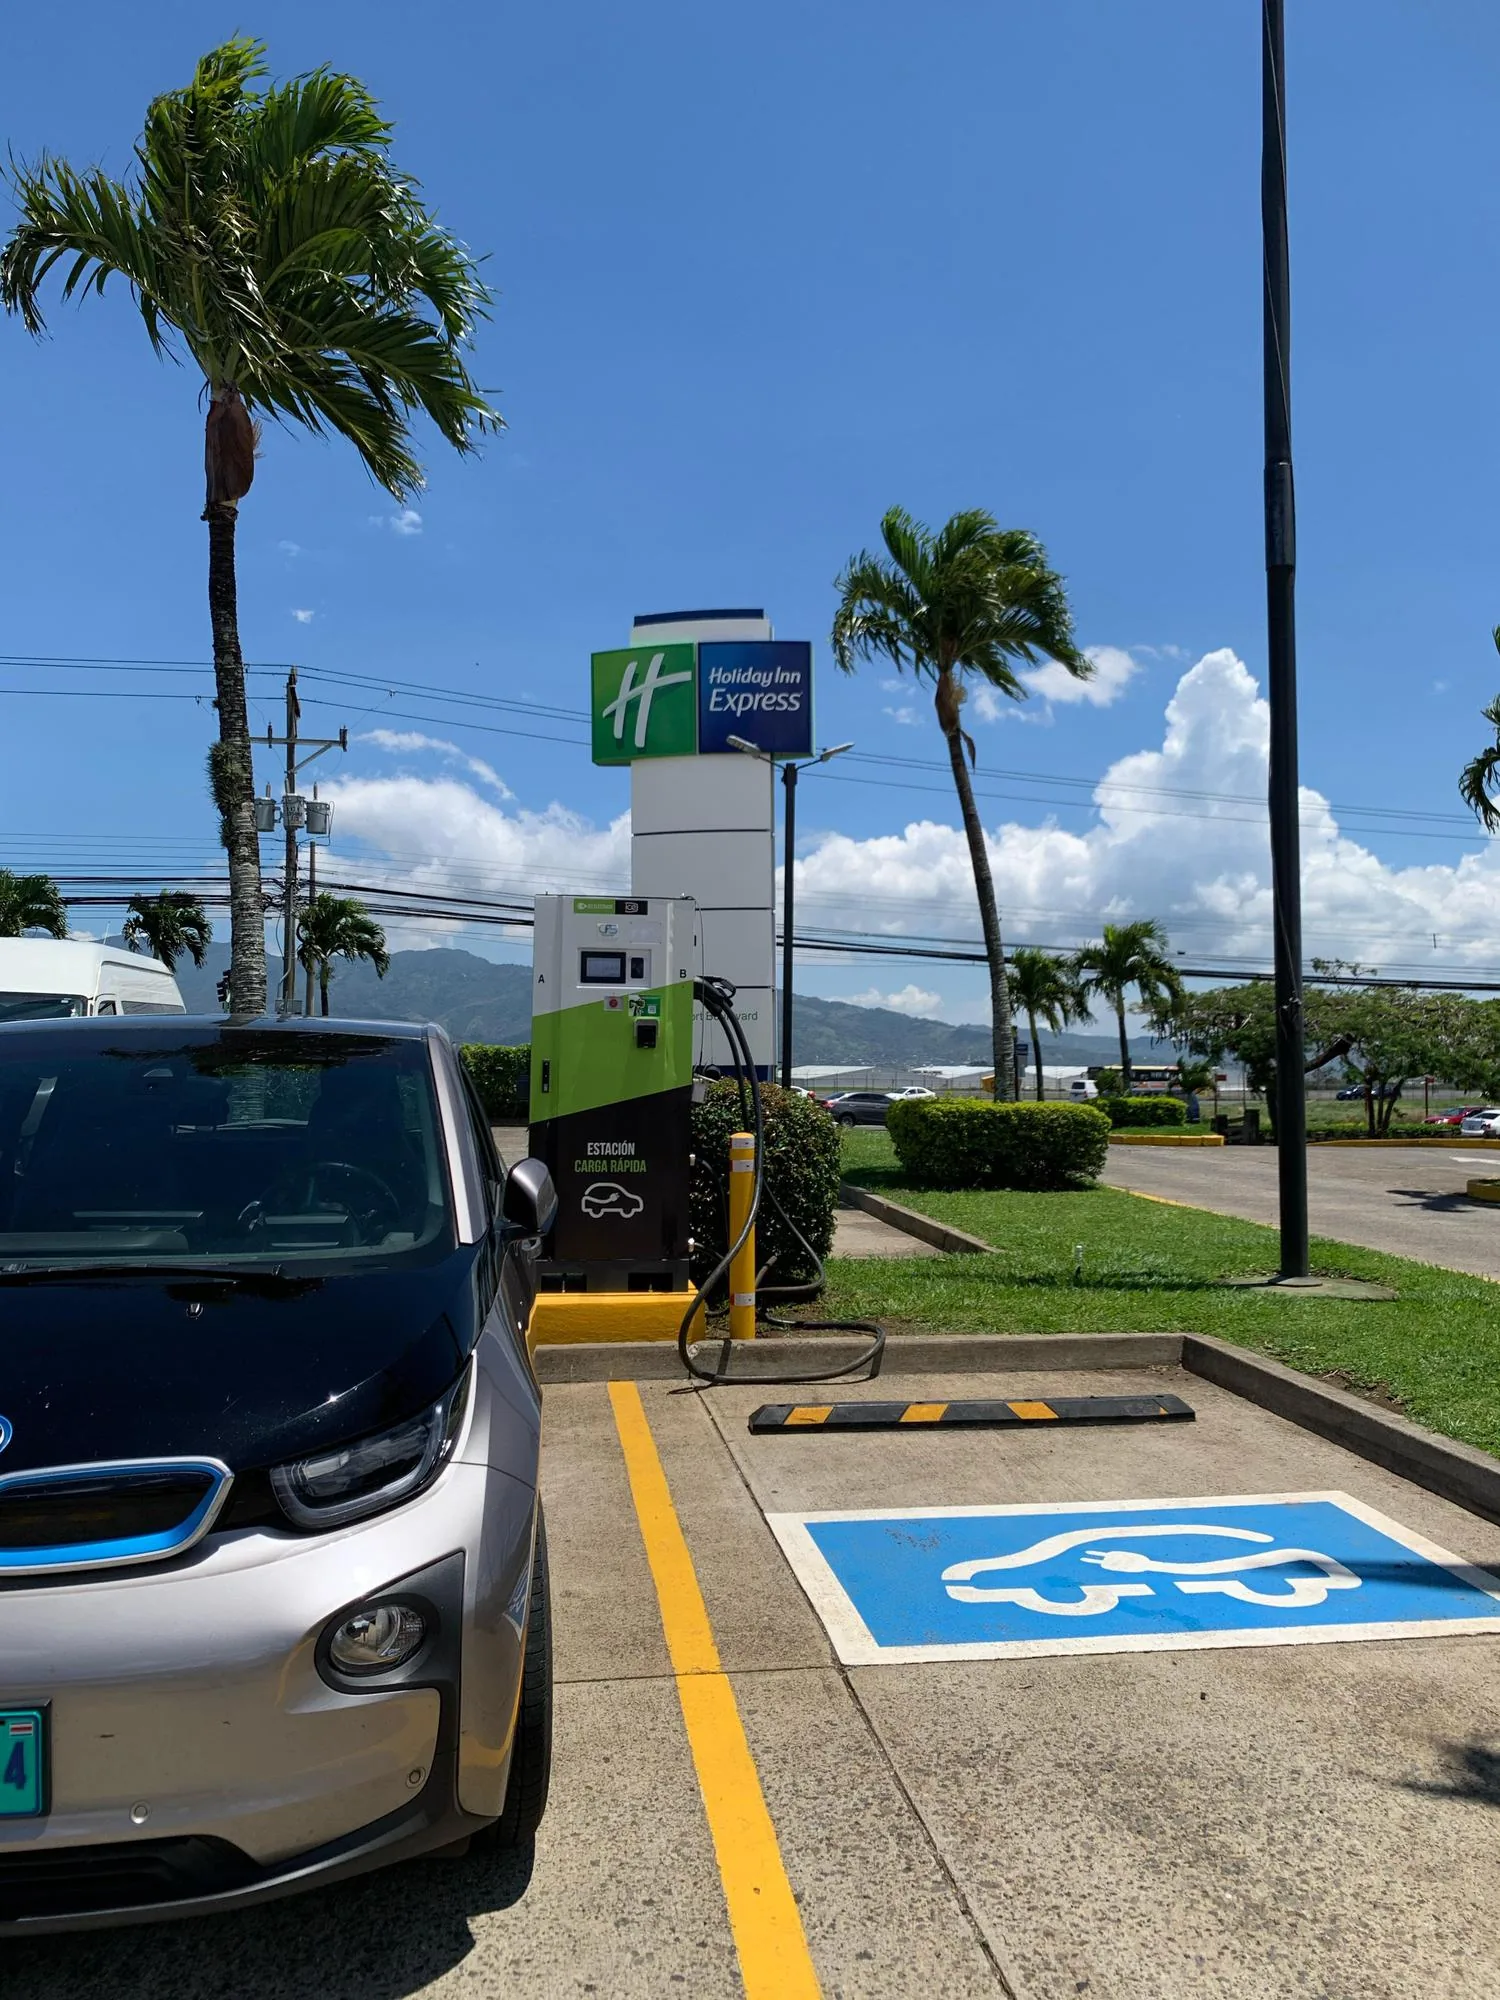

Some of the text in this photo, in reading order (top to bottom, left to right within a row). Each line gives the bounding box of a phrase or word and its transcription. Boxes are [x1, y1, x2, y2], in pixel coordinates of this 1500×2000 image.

[708, 666, 801, 688] Holiday Inn
[709, 688, 802, 717] Express
[537, 974, 545, 984] A
[679, 969, 687, 979] B
[587, 1140, 635, 1156] ESTACIÓN
[574, 1159, 647, 1173] CARGA RÁPIDA
